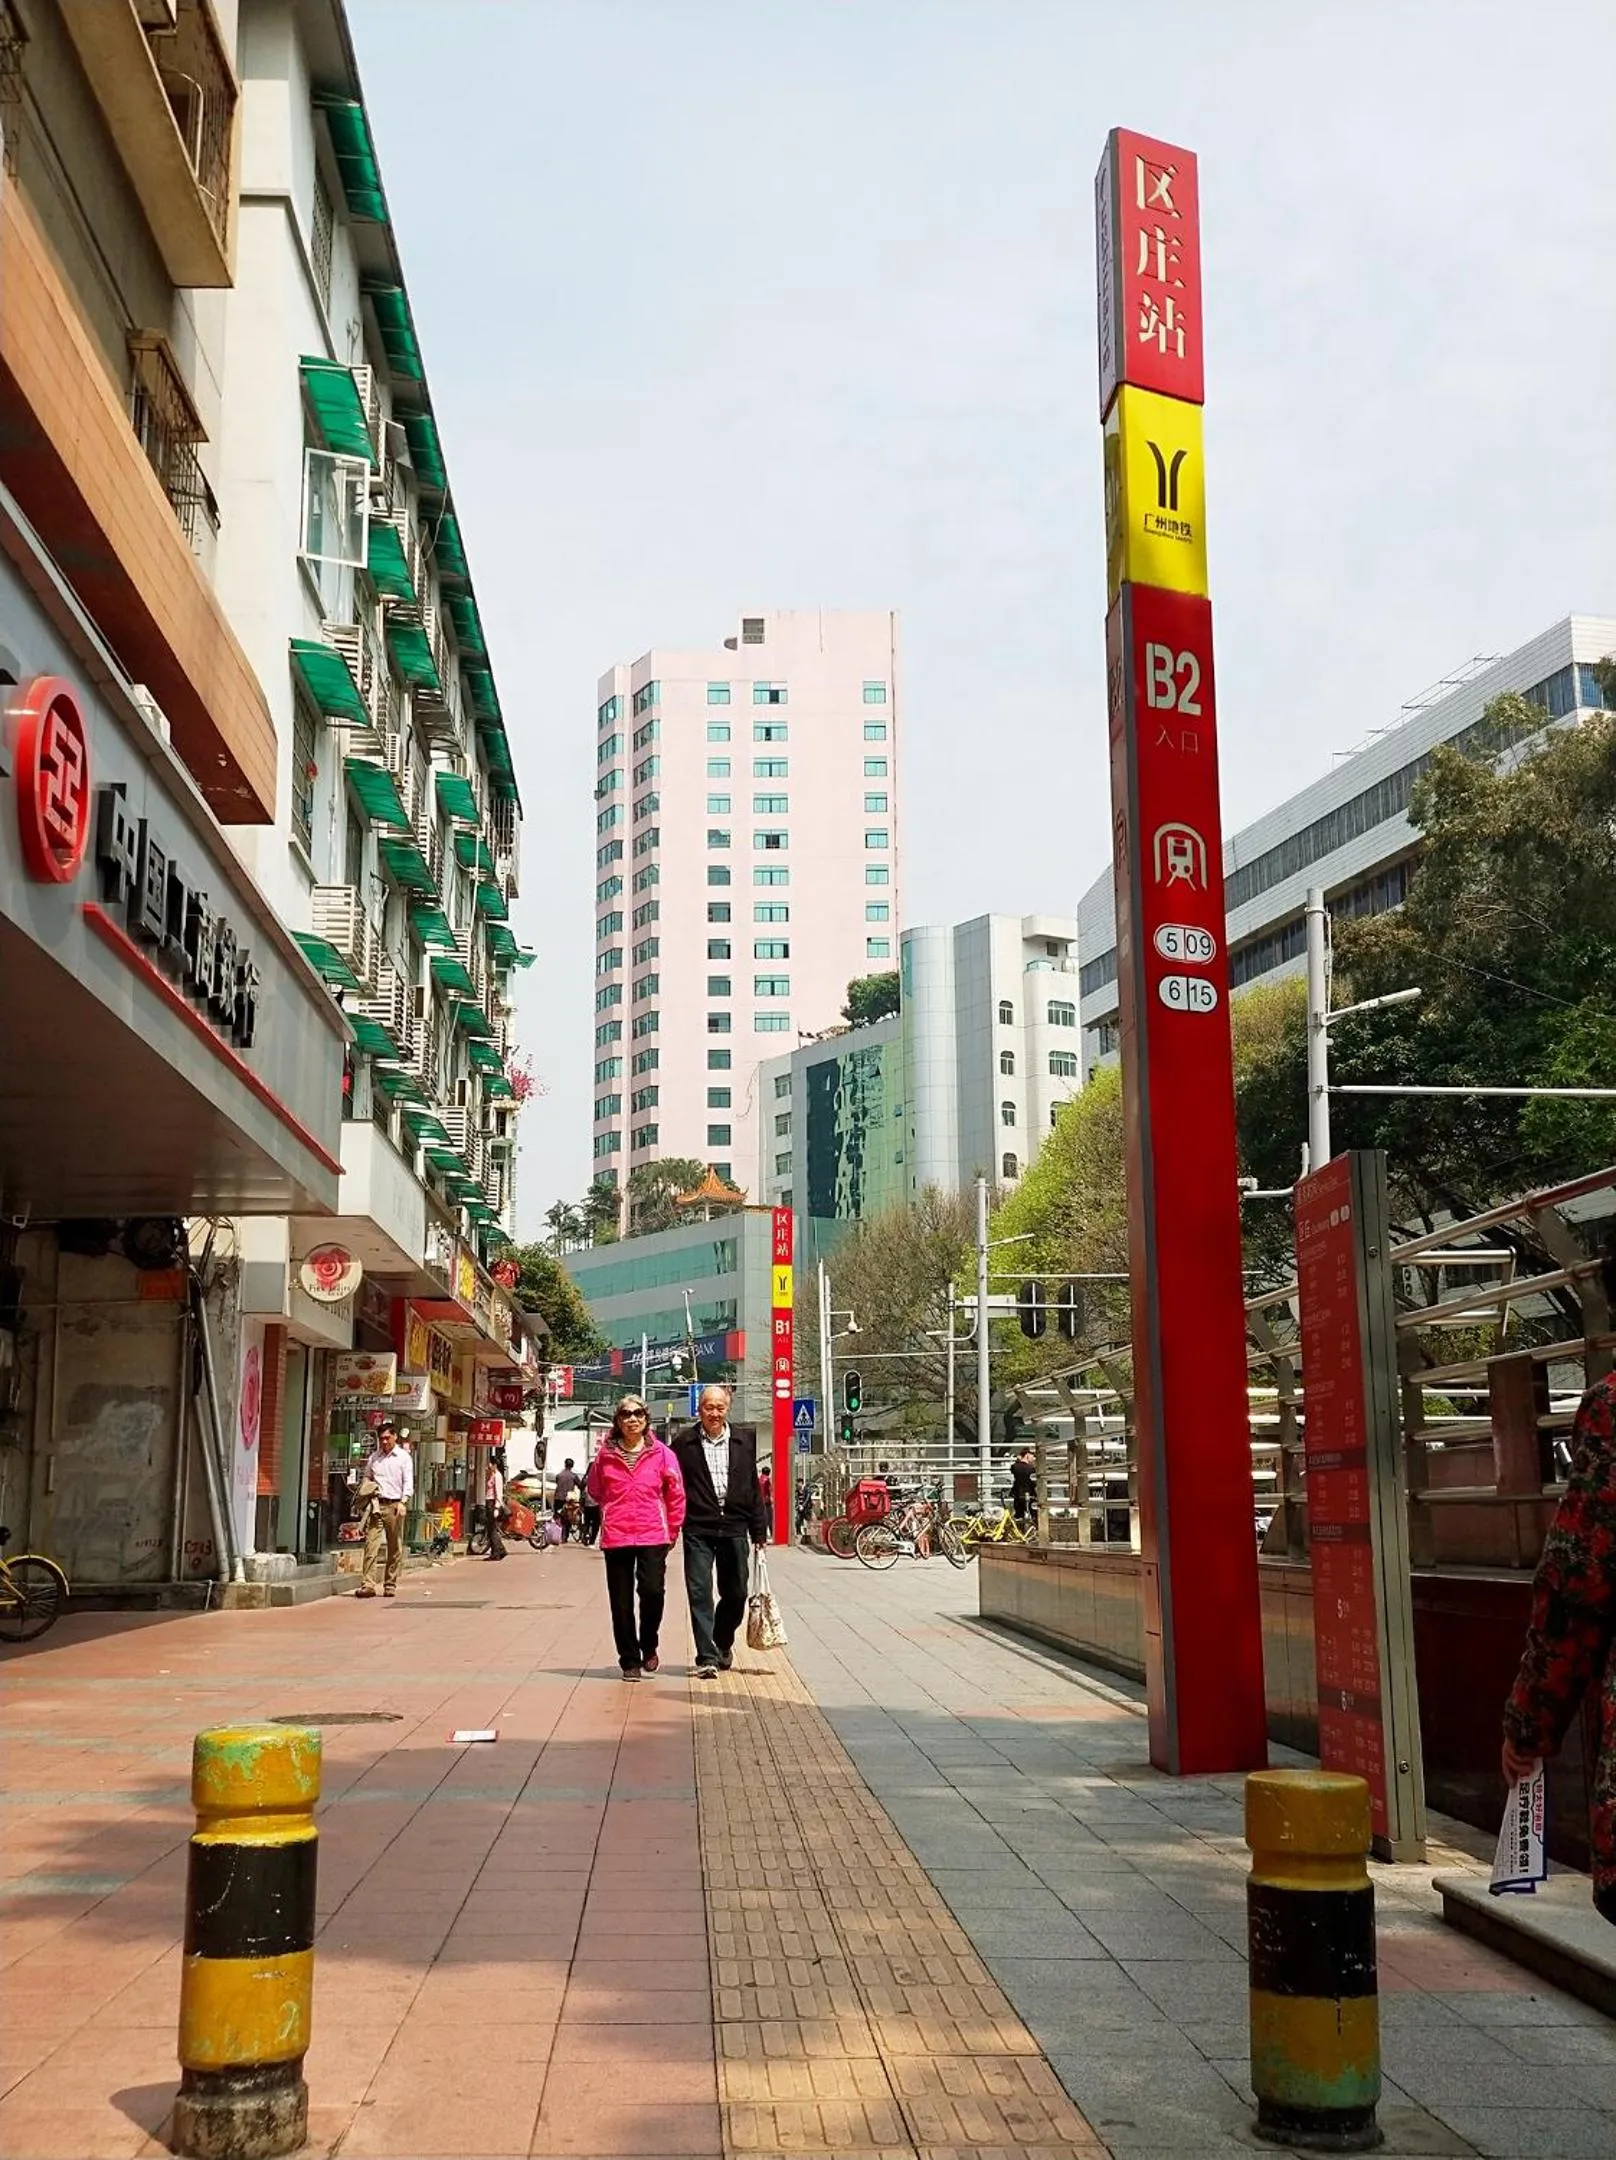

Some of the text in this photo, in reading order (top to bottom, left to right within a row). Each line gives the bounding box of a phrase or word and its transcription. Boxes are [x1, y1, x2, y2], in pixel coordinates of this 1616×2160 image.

[1134, 153, 1187, 360] 区庄站
[1143, 512, 1193, 539] 广州地铁
[1145, 641, 1202, 717] B2
[1155, 723, 1200, 755] 入口
[776, 1212, 790, 1257] 区庄站
[775, 1320, 790, 1335] B1
